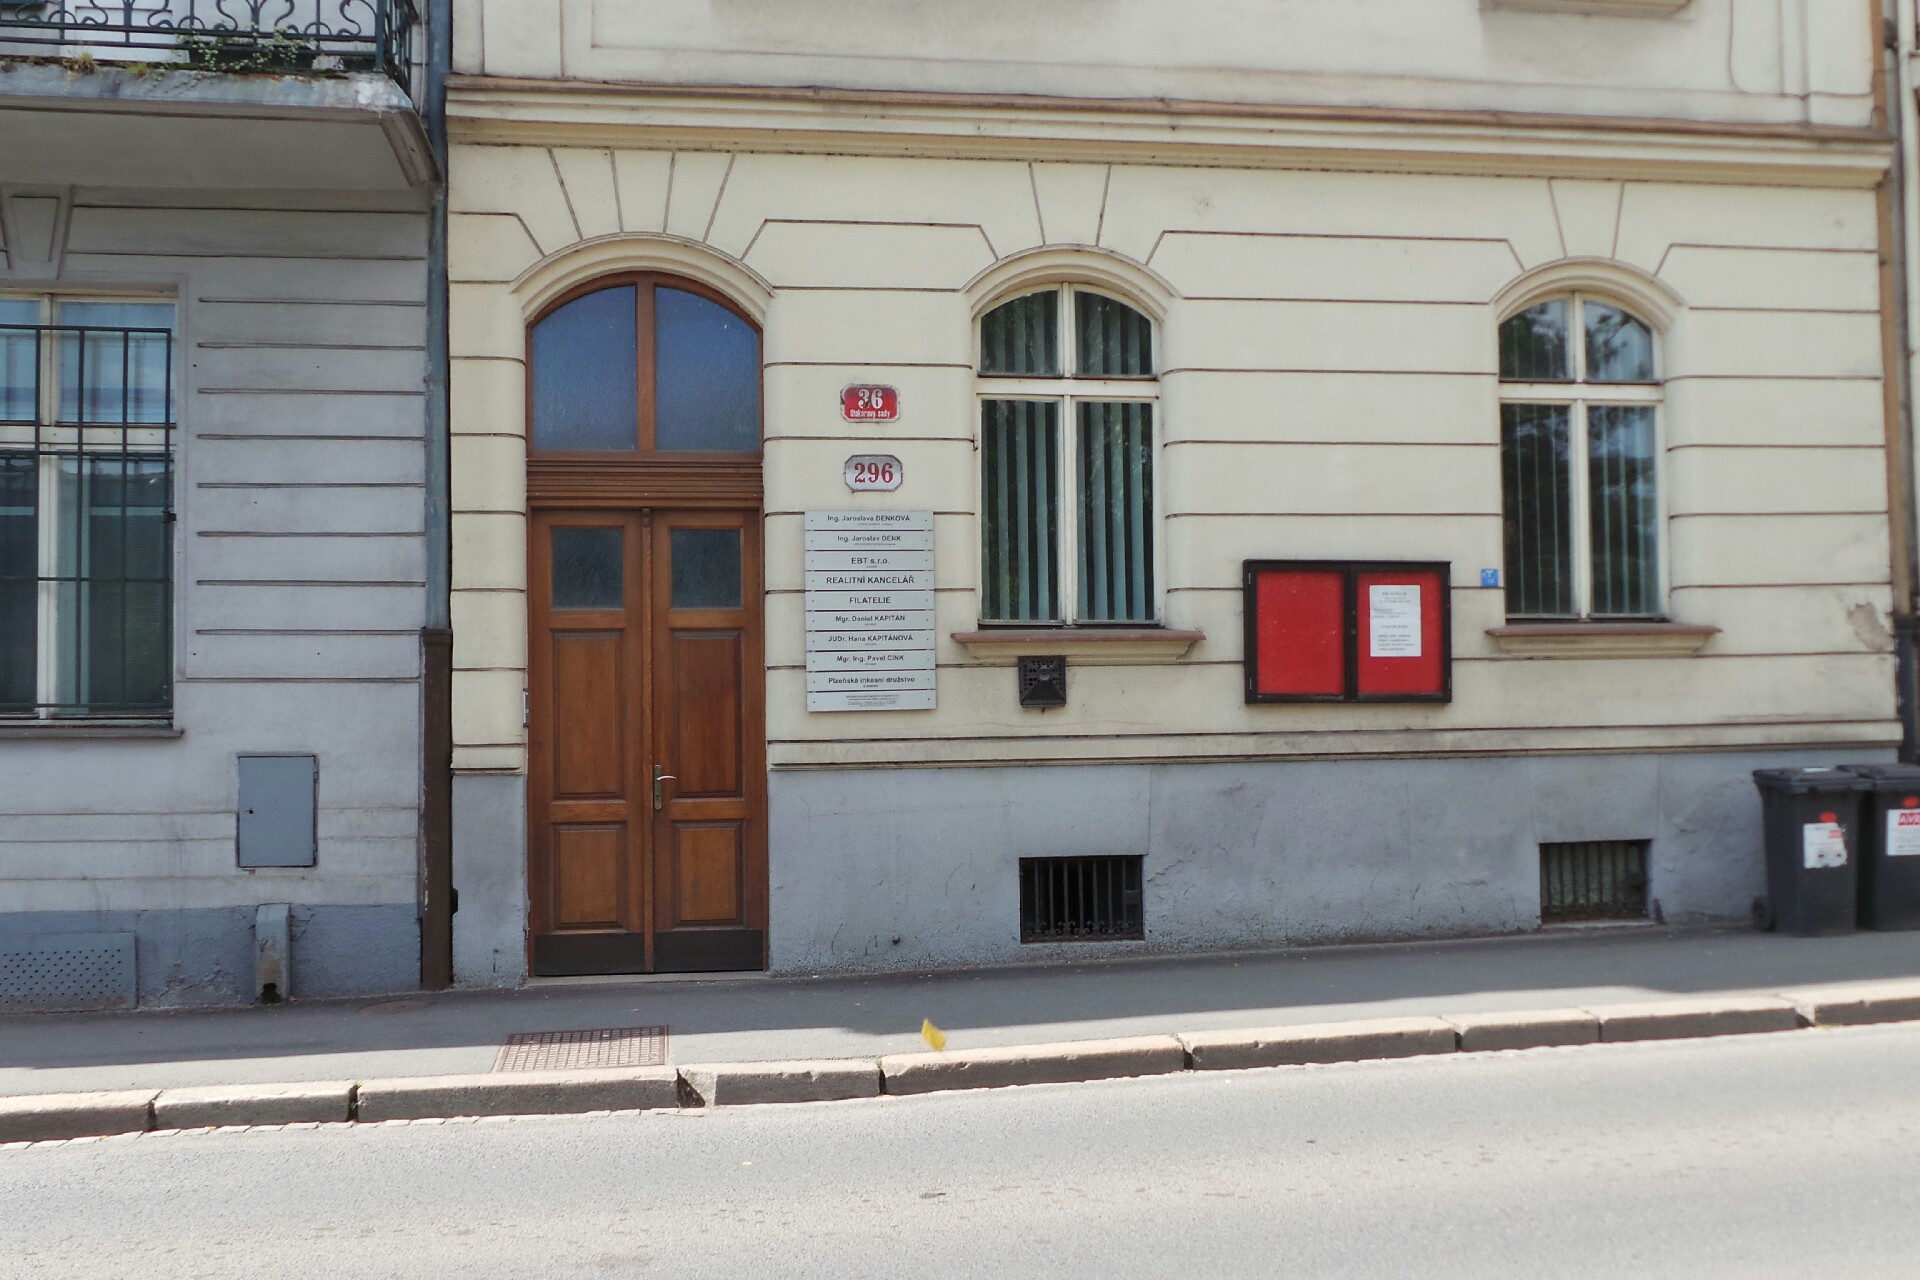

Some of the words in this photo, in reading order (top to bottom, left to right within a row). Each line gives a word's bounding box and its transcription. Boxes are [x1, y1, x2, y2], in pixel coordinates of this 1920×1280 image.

[858, 388, 883, 409] 36
[878, 409, 890, 418] sady
[854, 462, 894, 483] 296
[826, 576, 866, 584] REALITNÍ
[867, 575, 914, 584] KANCELÁŘ
[835, 615, 850, 623] Mgr.
[836, 655, 851, 663] Mgr.
